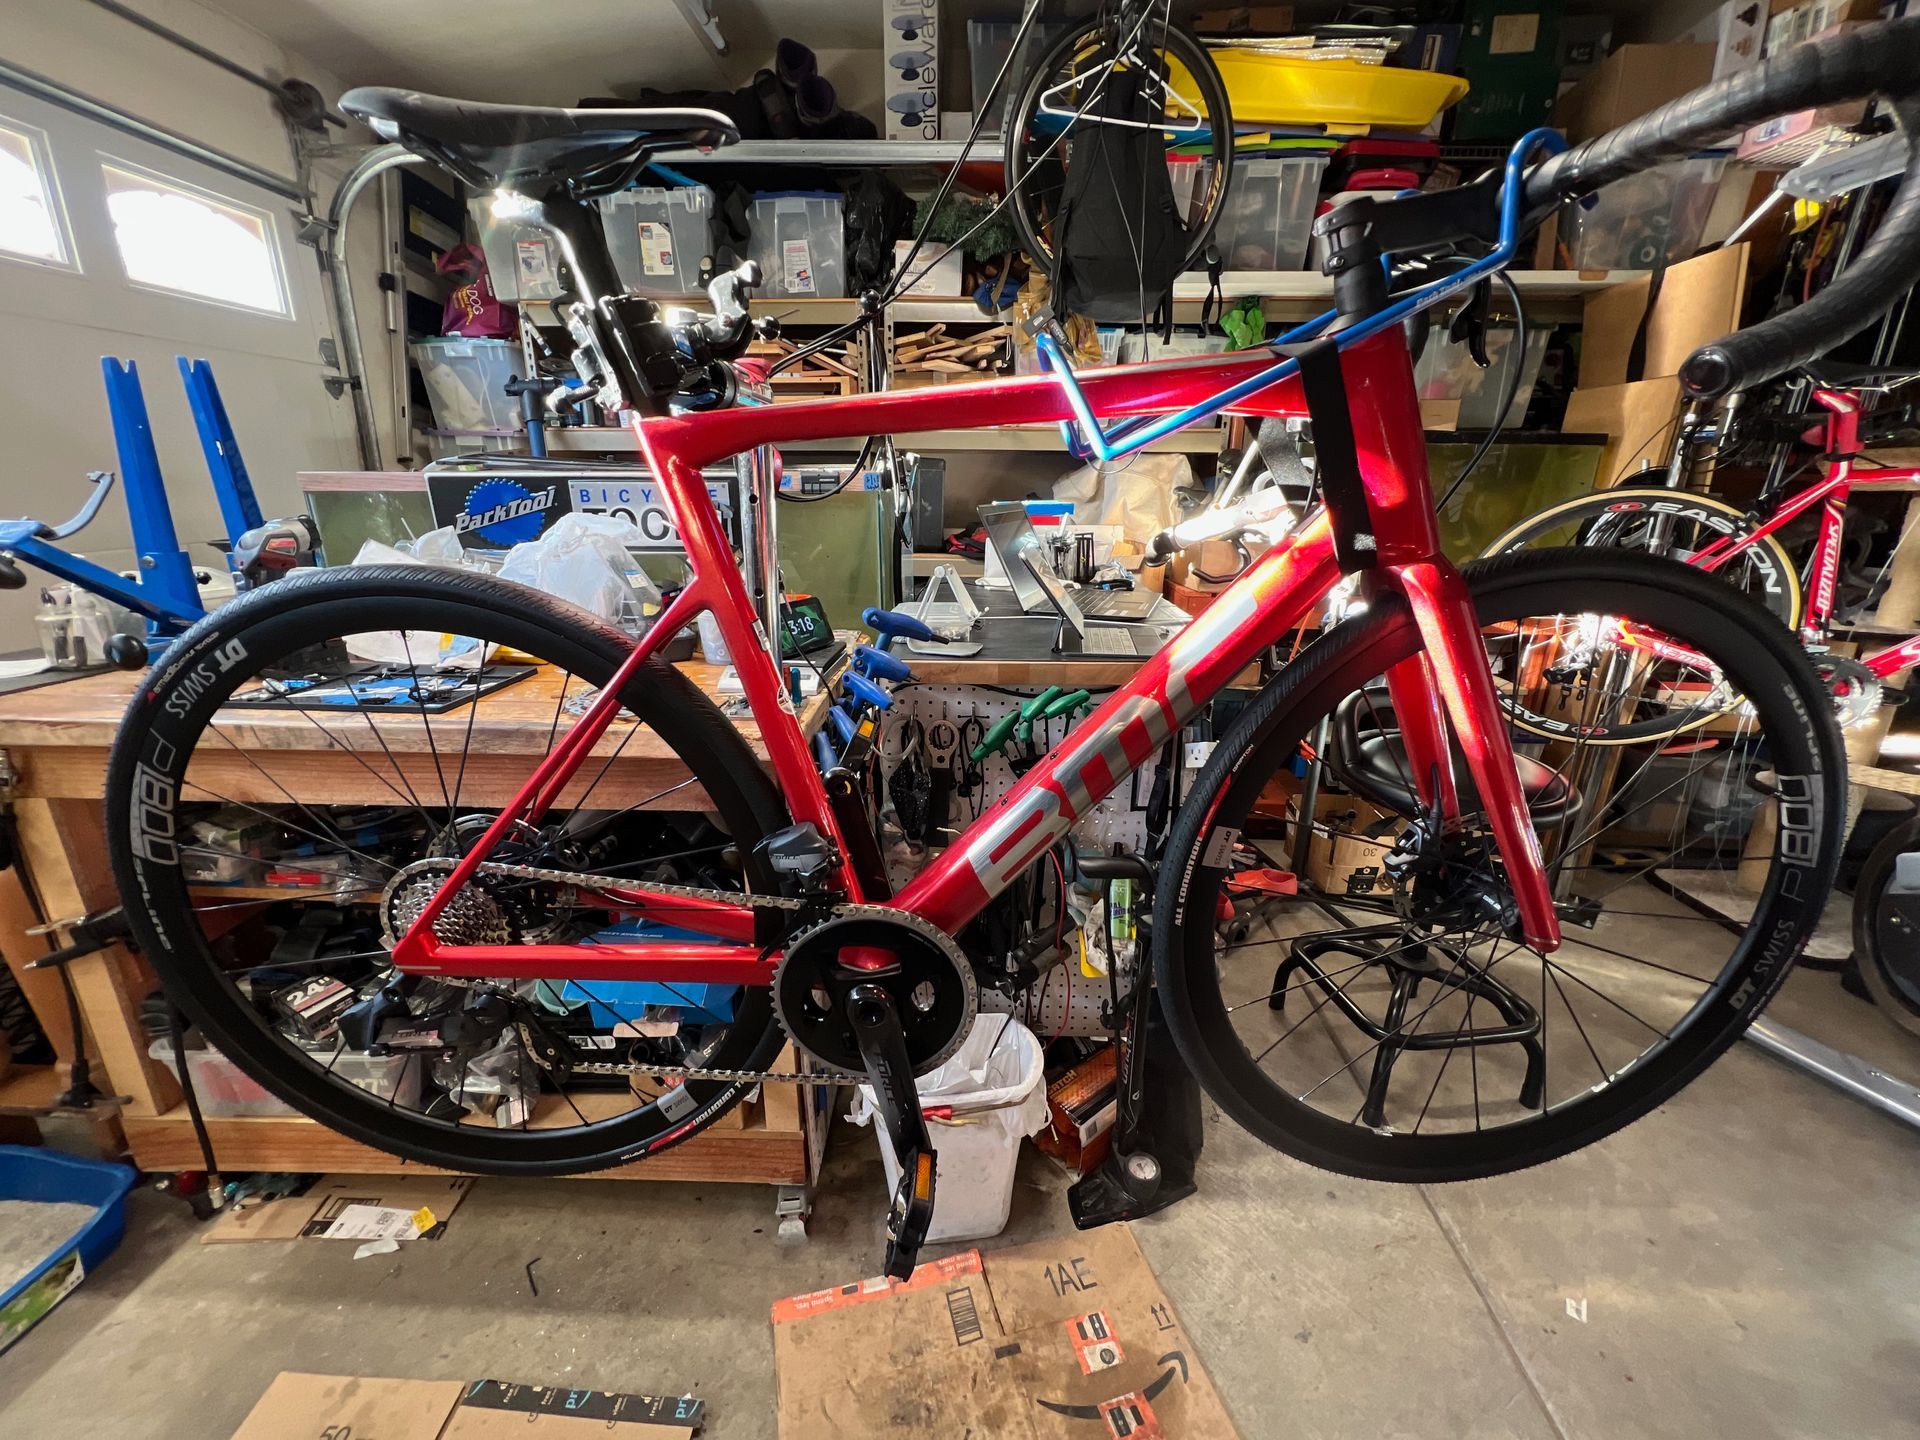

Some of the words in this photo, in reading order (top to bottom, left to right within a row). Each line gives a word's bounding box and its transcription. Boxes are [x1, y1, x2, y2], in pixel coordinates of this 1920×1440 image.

[467, 289, 484, 315] DOG
[1814, 521, 1841, 612] SPECIALIZED
[787, 616, 815, 635] 3:18
[214, 637, 248, 673] DT
[165, 663, 216, 719] SWISS
[1232, 743, 1255, 773] GRIPTON
[130, 760, 179, 866] 1800
[1223, 830, 1232, 843] DT
[1214, 844, 1227, 866] SWISS
[1362, 847, 1378, 857] 30
[1728, 977, 1757, 1010] DT
[1753, 919, 1796, 977] SWISS
[1777, 773, 1824, 868] 1800
[1174, 905, 1185, 928] ALL
[287, 975, 332, 1006] 24"
[663, 1105, 674, 1115] DT
[1044, 1256, 1098, 1297] 1AE
[811, 1295, 834, 1309] Spend
